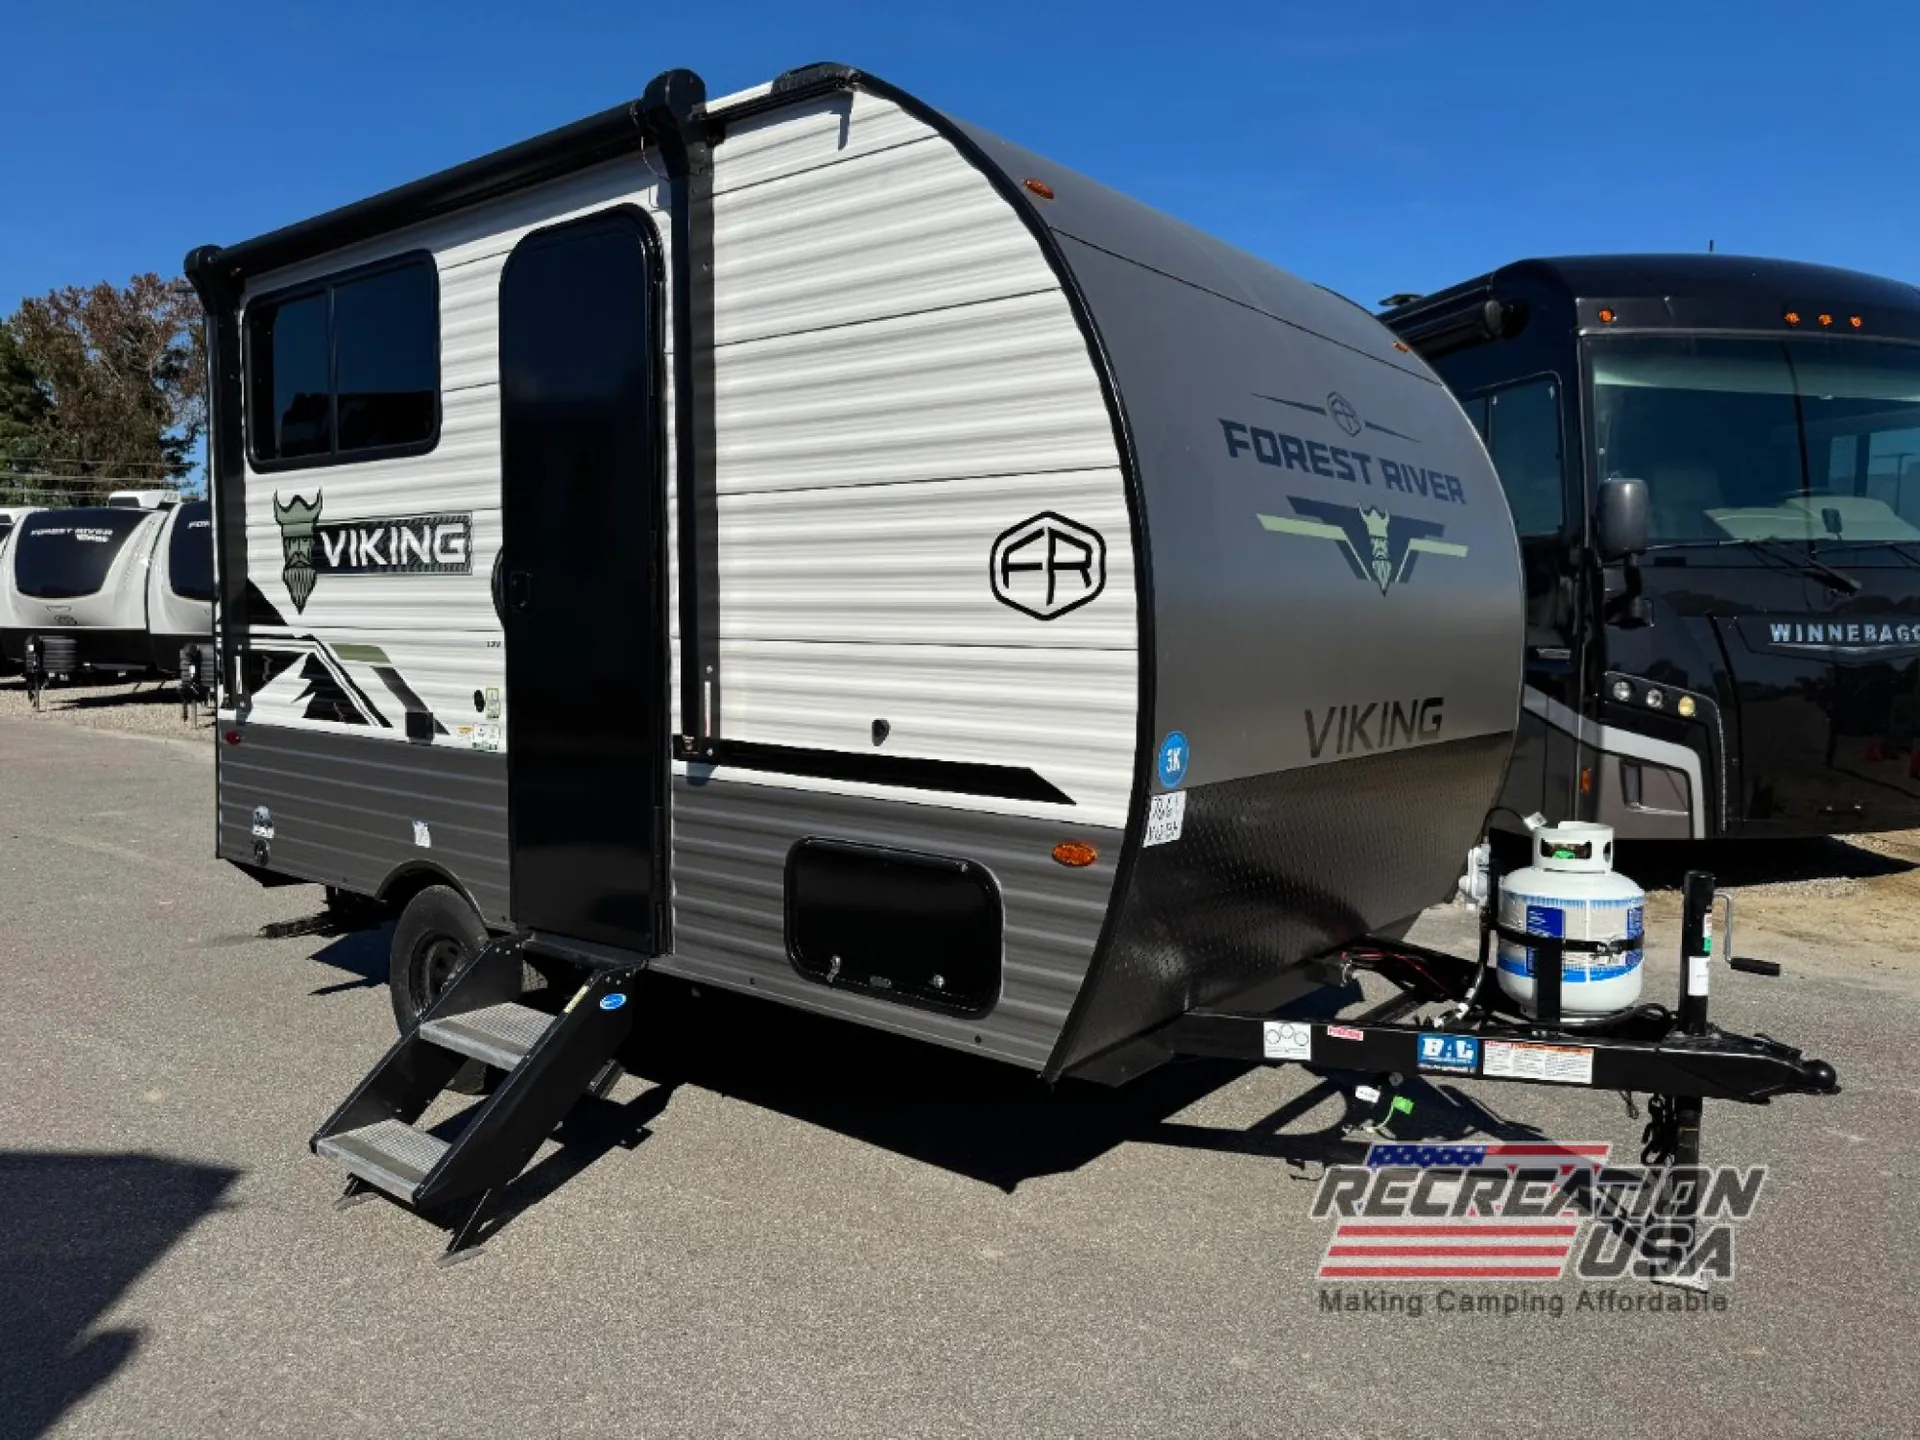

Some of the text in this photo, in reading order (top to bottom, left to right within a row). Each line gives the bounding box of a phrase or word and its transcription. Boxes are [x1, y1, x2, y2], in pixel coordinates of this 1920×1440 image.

[1218, 418, 1466, 504] FOREST RIVER
[320, 523, 466, 567] VIKING
[1304, 697, 1445, 758] VIKING
